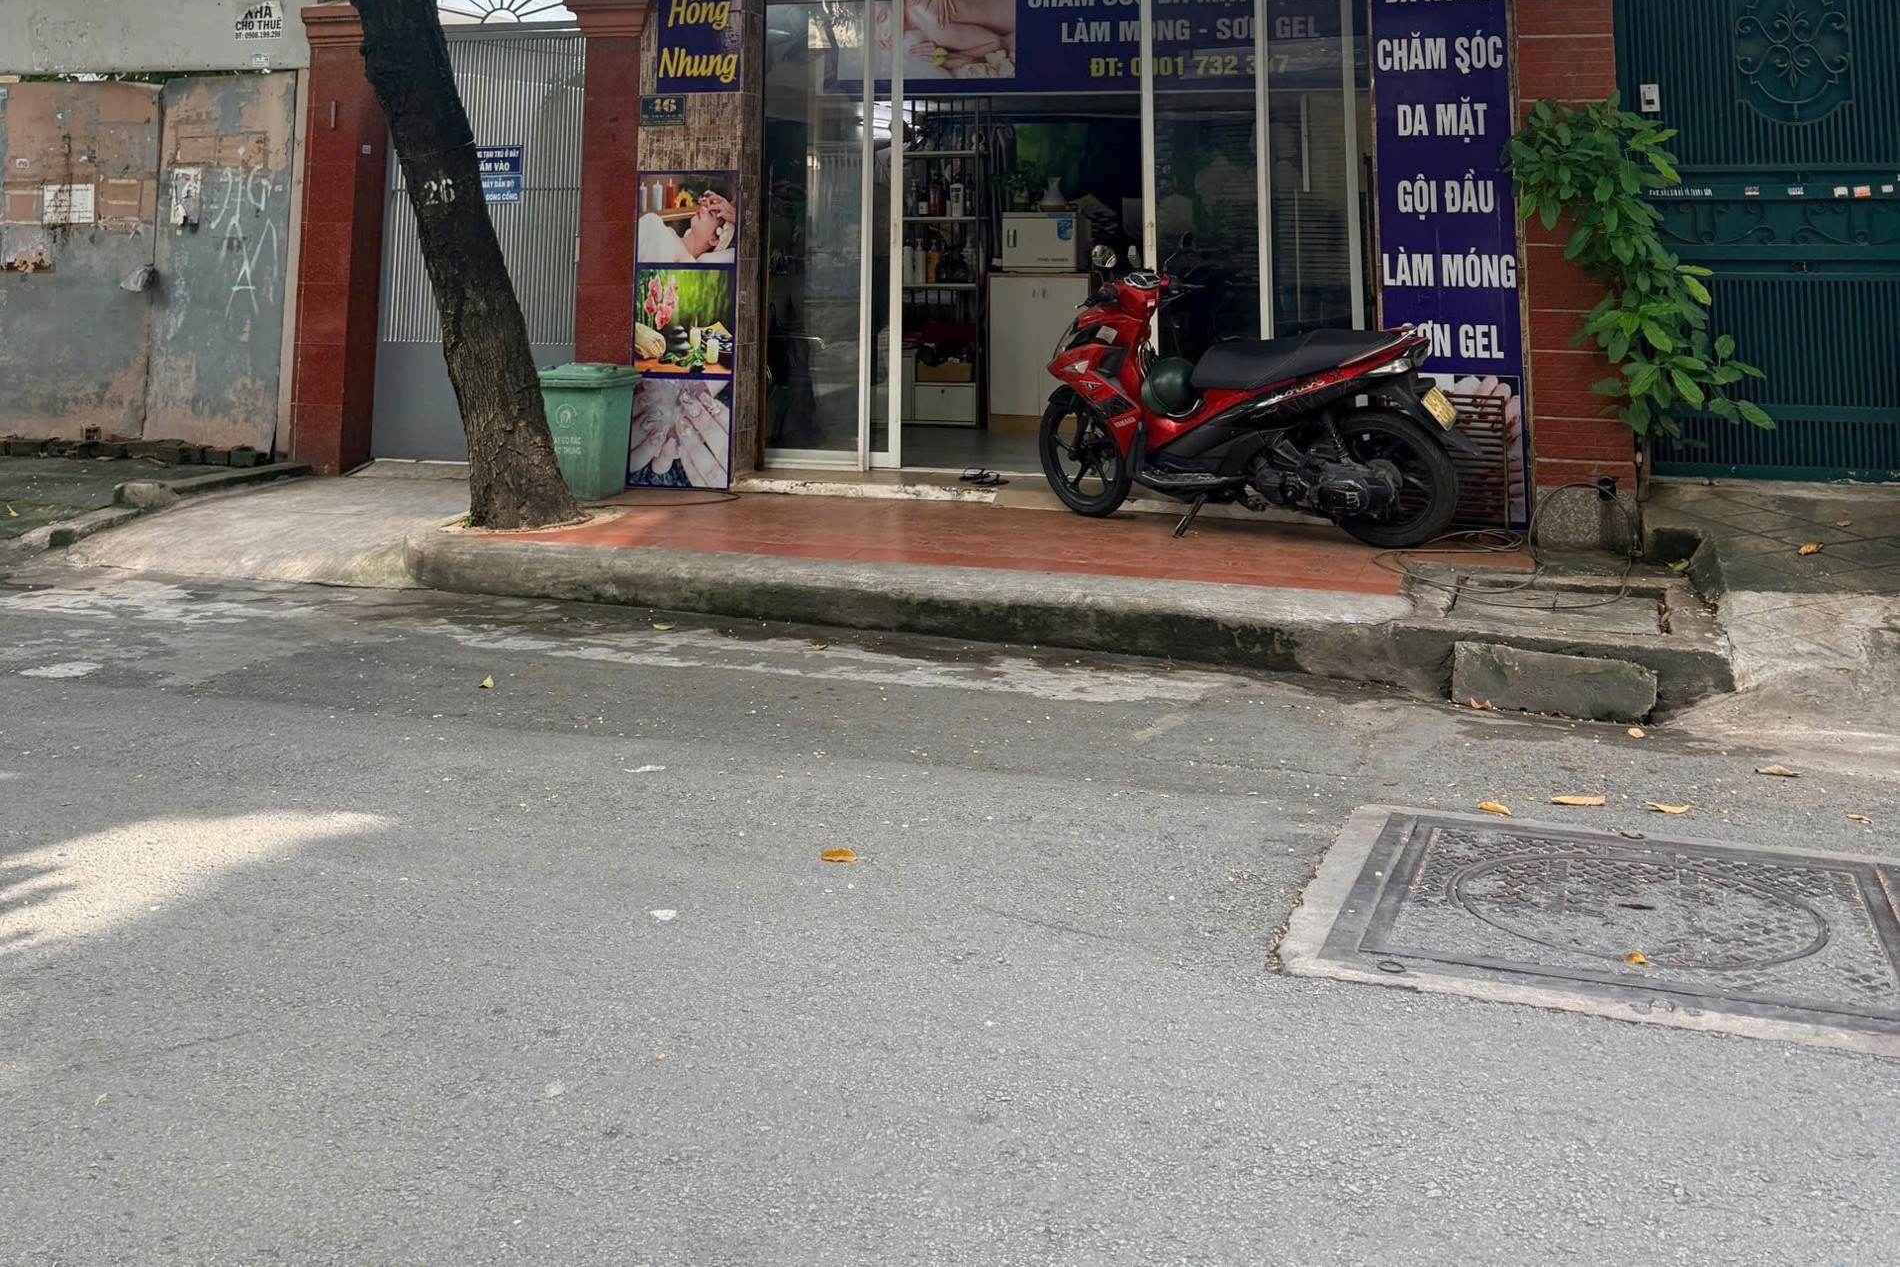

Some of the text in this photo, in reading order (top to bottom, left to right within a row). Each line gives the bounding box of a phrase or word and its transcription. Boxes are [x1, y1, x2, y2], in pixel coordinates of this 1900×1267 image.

[235, 16, 282, 31] CHO THUÊ
[1061, 18, 1110, 43] LÀM
[1275, 16, 1321, 39] GEL
[658, 47, 738, 84] Nhung
[1090, 57, 1123, 77] ĐT:
[1194, 54, 1238, 75] 732
[1377, 29, 1503, 74] CHĂM SÓC
[1397, 96, 1487, 143] DA MẶT
[479, 159, 510, 172] ẤM VÀO
[1397, 168, 1495, 221] GỘI ĐẦU
[1382, 246, 1517, 289] LÀM MÓNG
[1459, 322, 1505, 359] GEL
